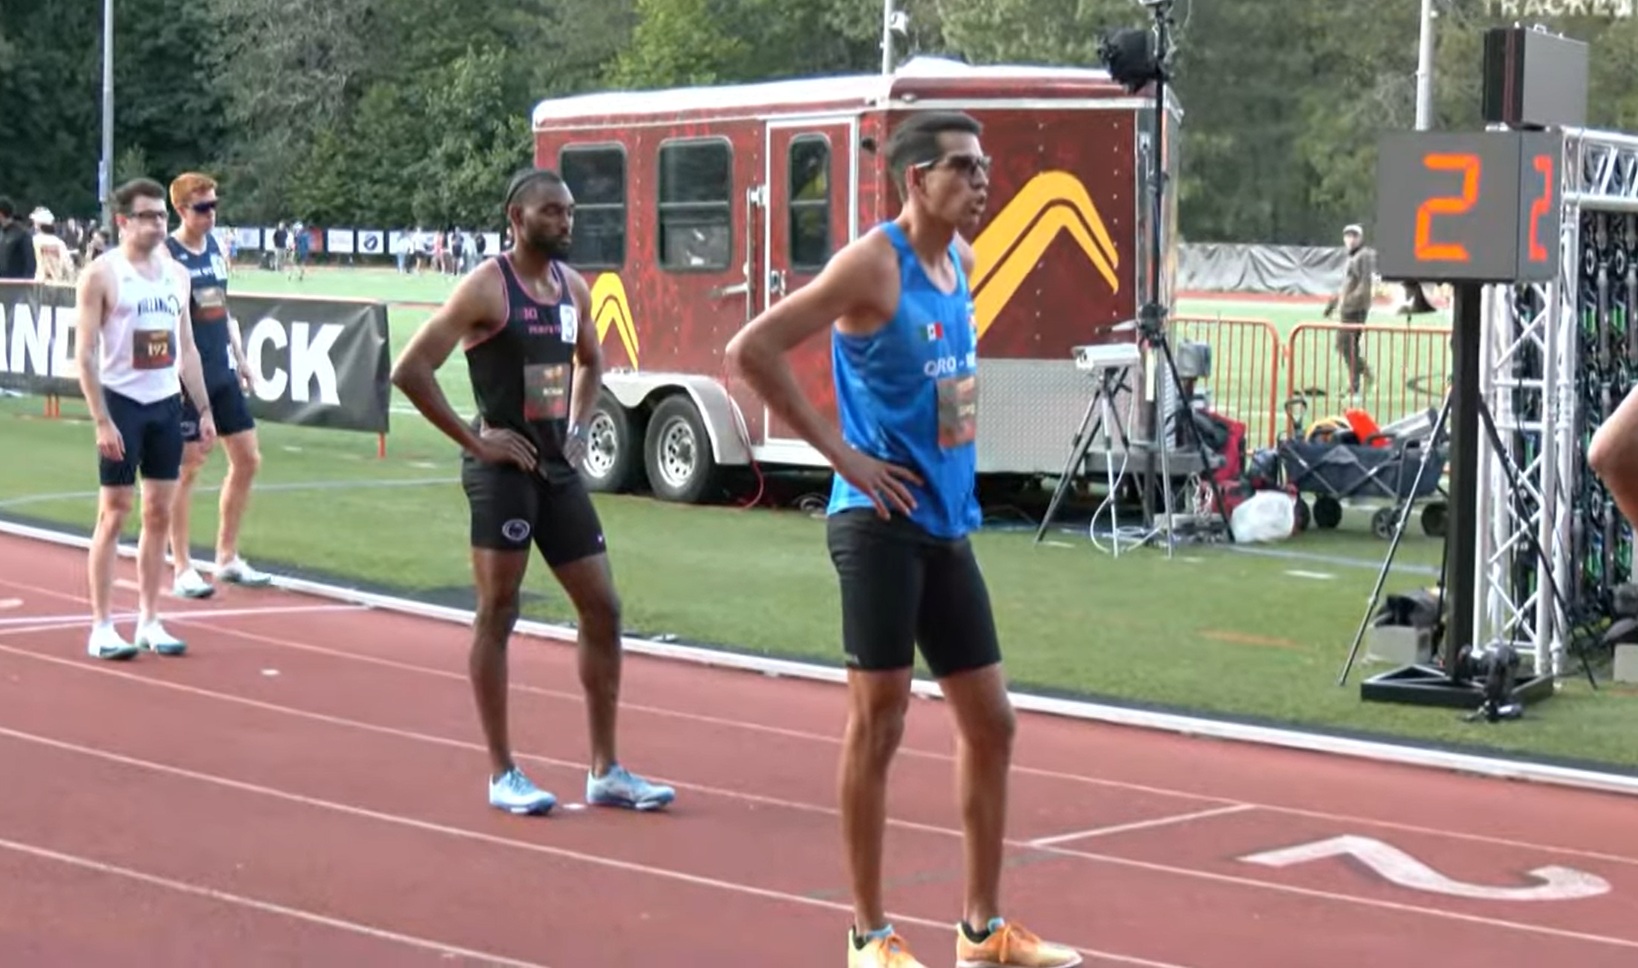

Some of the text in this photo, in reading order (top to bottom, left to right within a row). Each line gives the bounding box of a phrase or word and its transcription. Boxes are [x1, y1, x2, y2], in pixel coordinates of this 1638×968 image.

[1415, 154, 1480, 260] 2
[1528, 155, 1553, 261] 2
[0, 302, 345, 406] ND CK
[1236, 835, 1611, 901] 2
